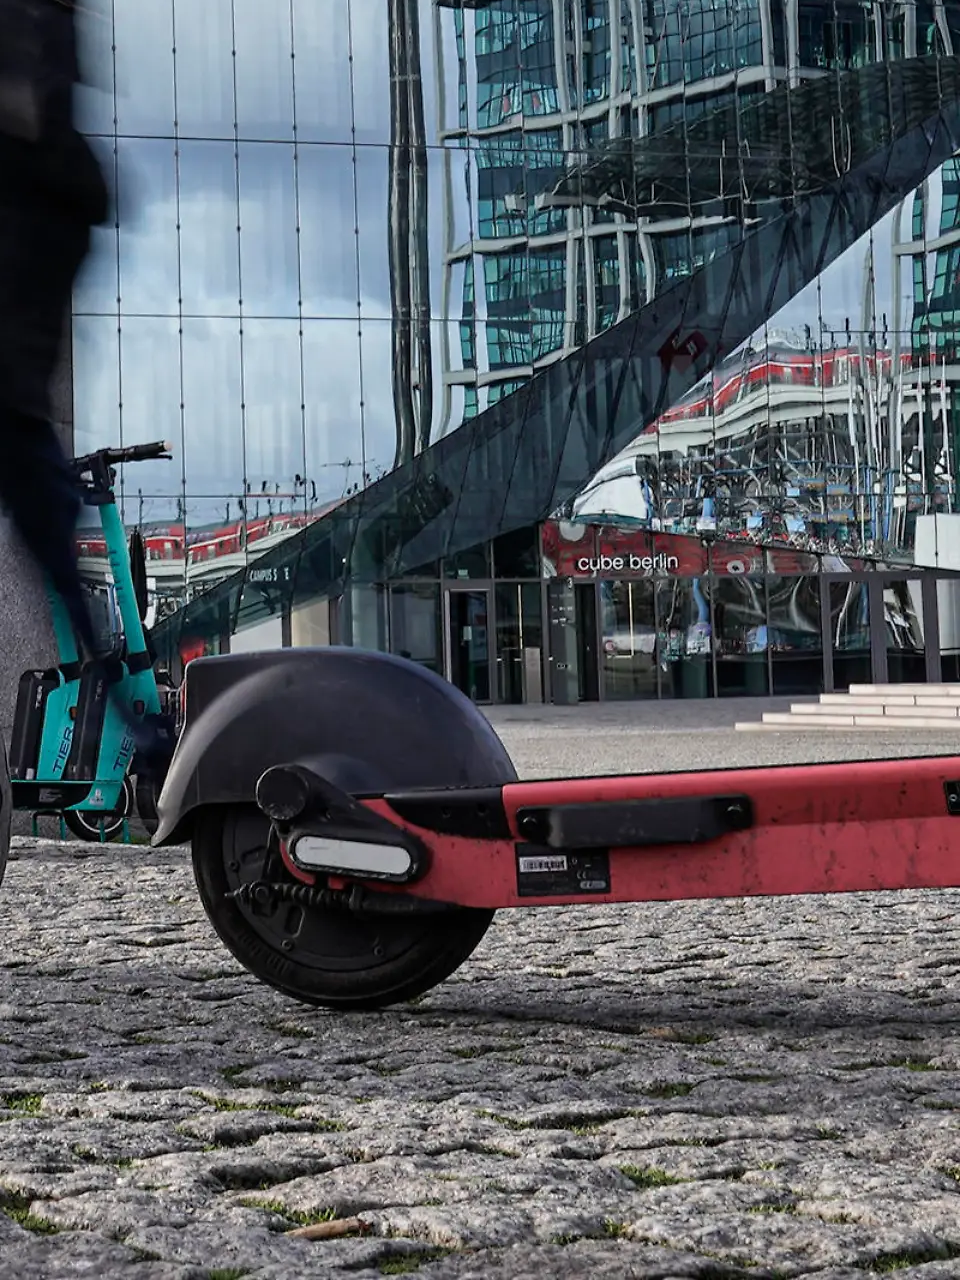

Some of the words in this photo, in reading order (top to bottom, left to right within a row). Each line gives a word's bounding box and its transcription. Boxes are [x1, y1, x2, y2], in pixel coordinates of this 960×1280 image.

[578, 555, 624, 571] cube
[629, 553, 679, 570] berlin
[53, 726, 74, 773] TIER
